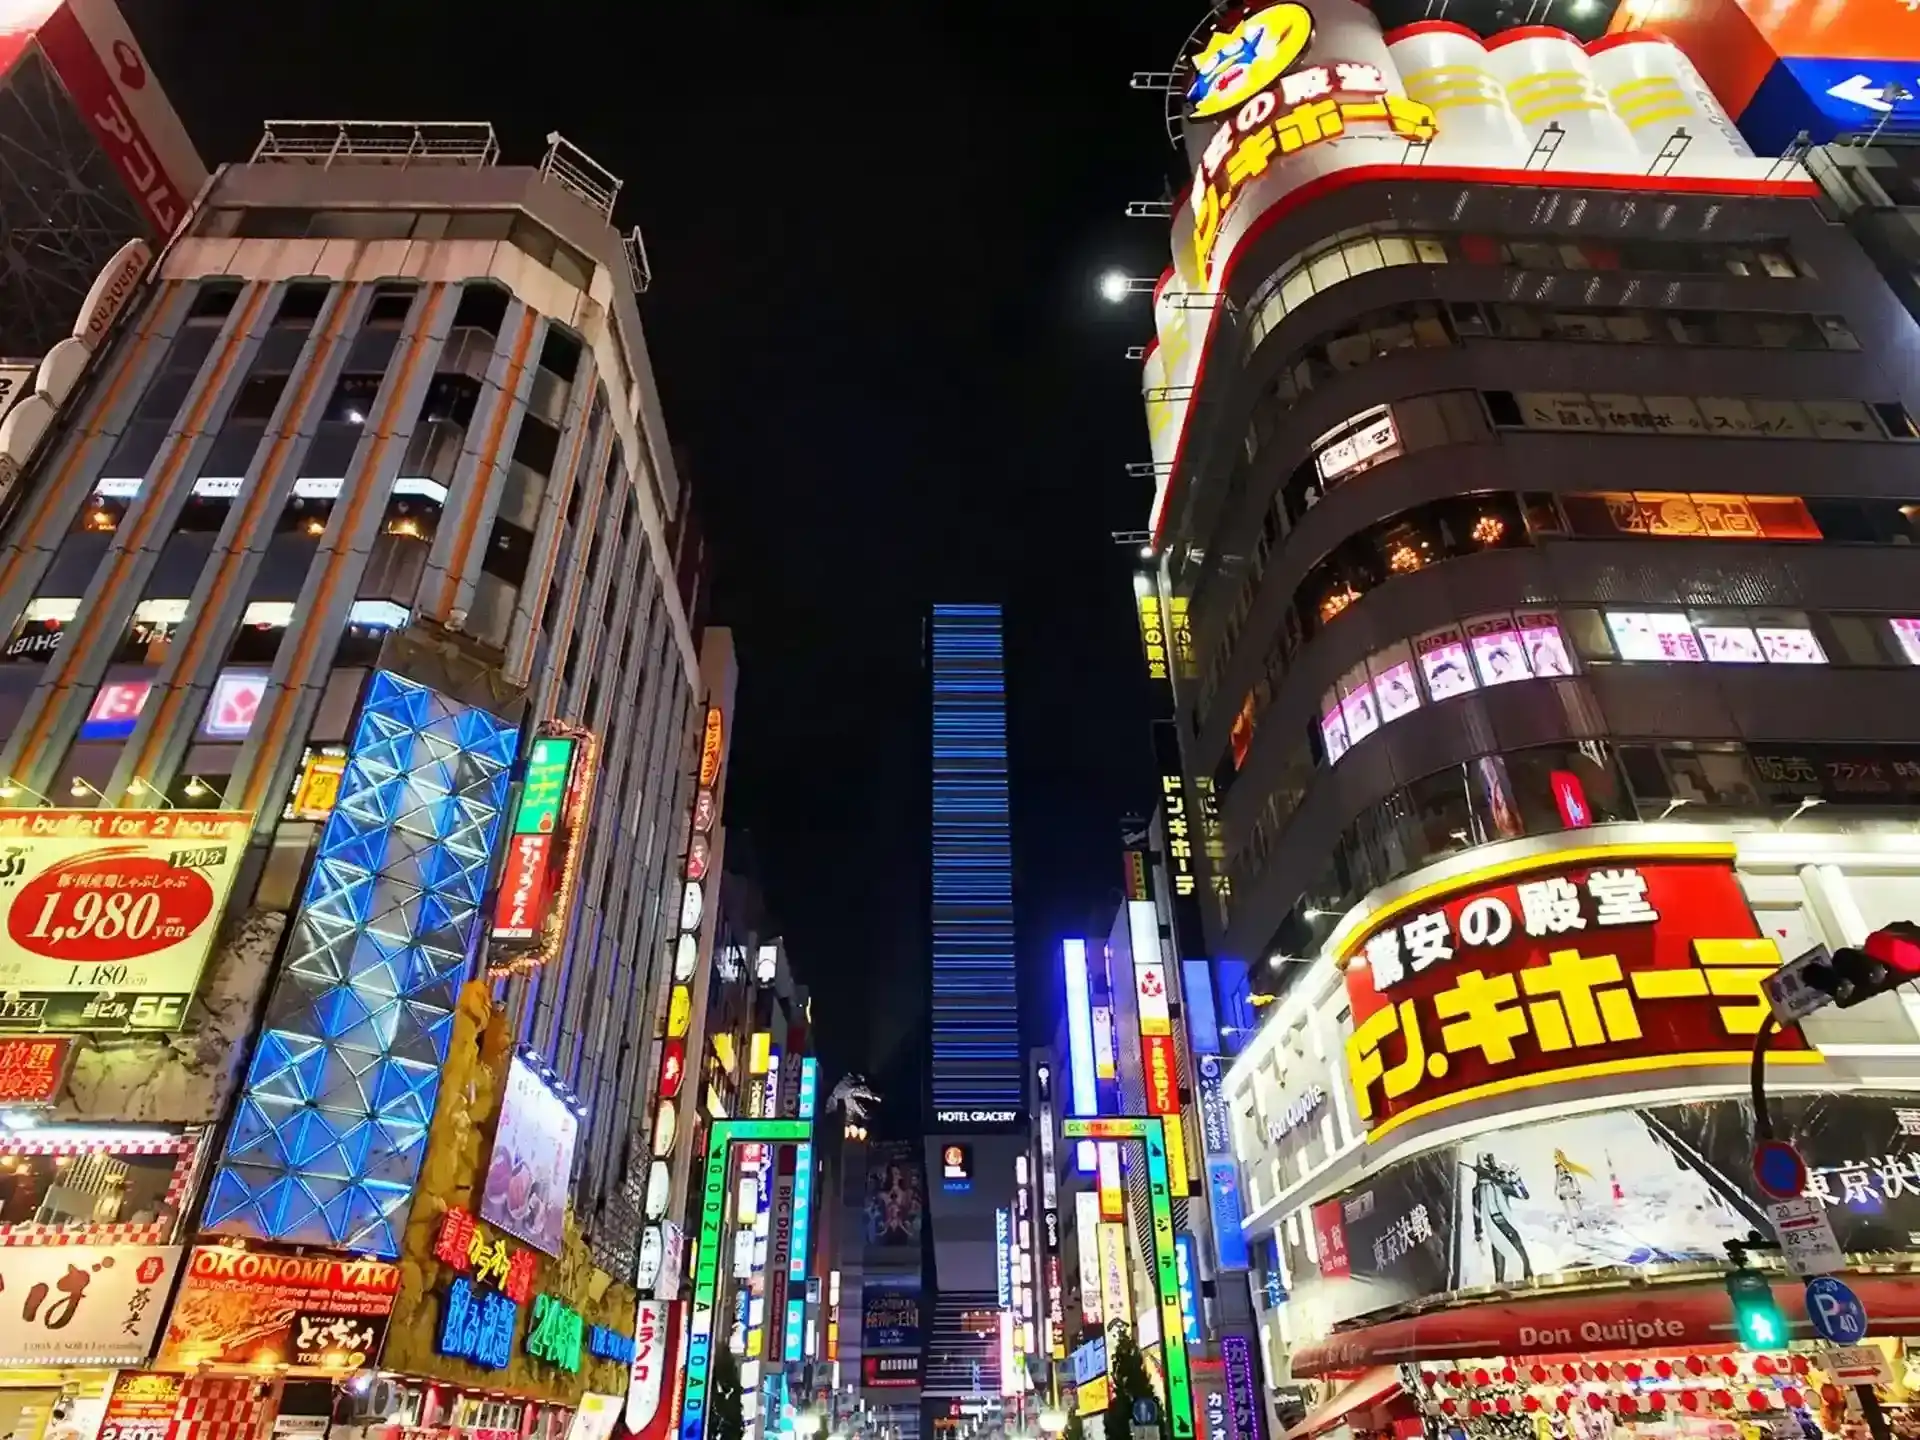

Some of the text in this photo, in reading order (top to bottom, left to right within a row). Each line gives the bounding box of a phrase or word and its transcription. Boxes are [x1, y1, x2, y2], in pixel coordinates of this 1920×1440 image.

[32, 814, 104, 834] buffet
[109, 815, 145, 834] for
[149, 815, 169, 834] 2
[173, 849, 222, 868] 120分
[27, 891, 185, 945] 1,980 yen
[937, 1111, 1017, 1122] HOTEL GRACERY
[1801, 1153, 1920, 1209] 東京決
[195, 1251, 400, 1289] OKONOMI YAKI
[686, 1163, 723, 1411] GODZILLA ROAD
[1153, 1183, 1183, 1386] ゴジラロード
[0, 1256, 116, 1331] ば
[1814, 1293, 1840, 1336] P
[634, 1308, 656, 1381] トラノコ
[1519, 1317, 1685, 1346] Don Quijote
[1840, 1314, 1858, 1333] 40
